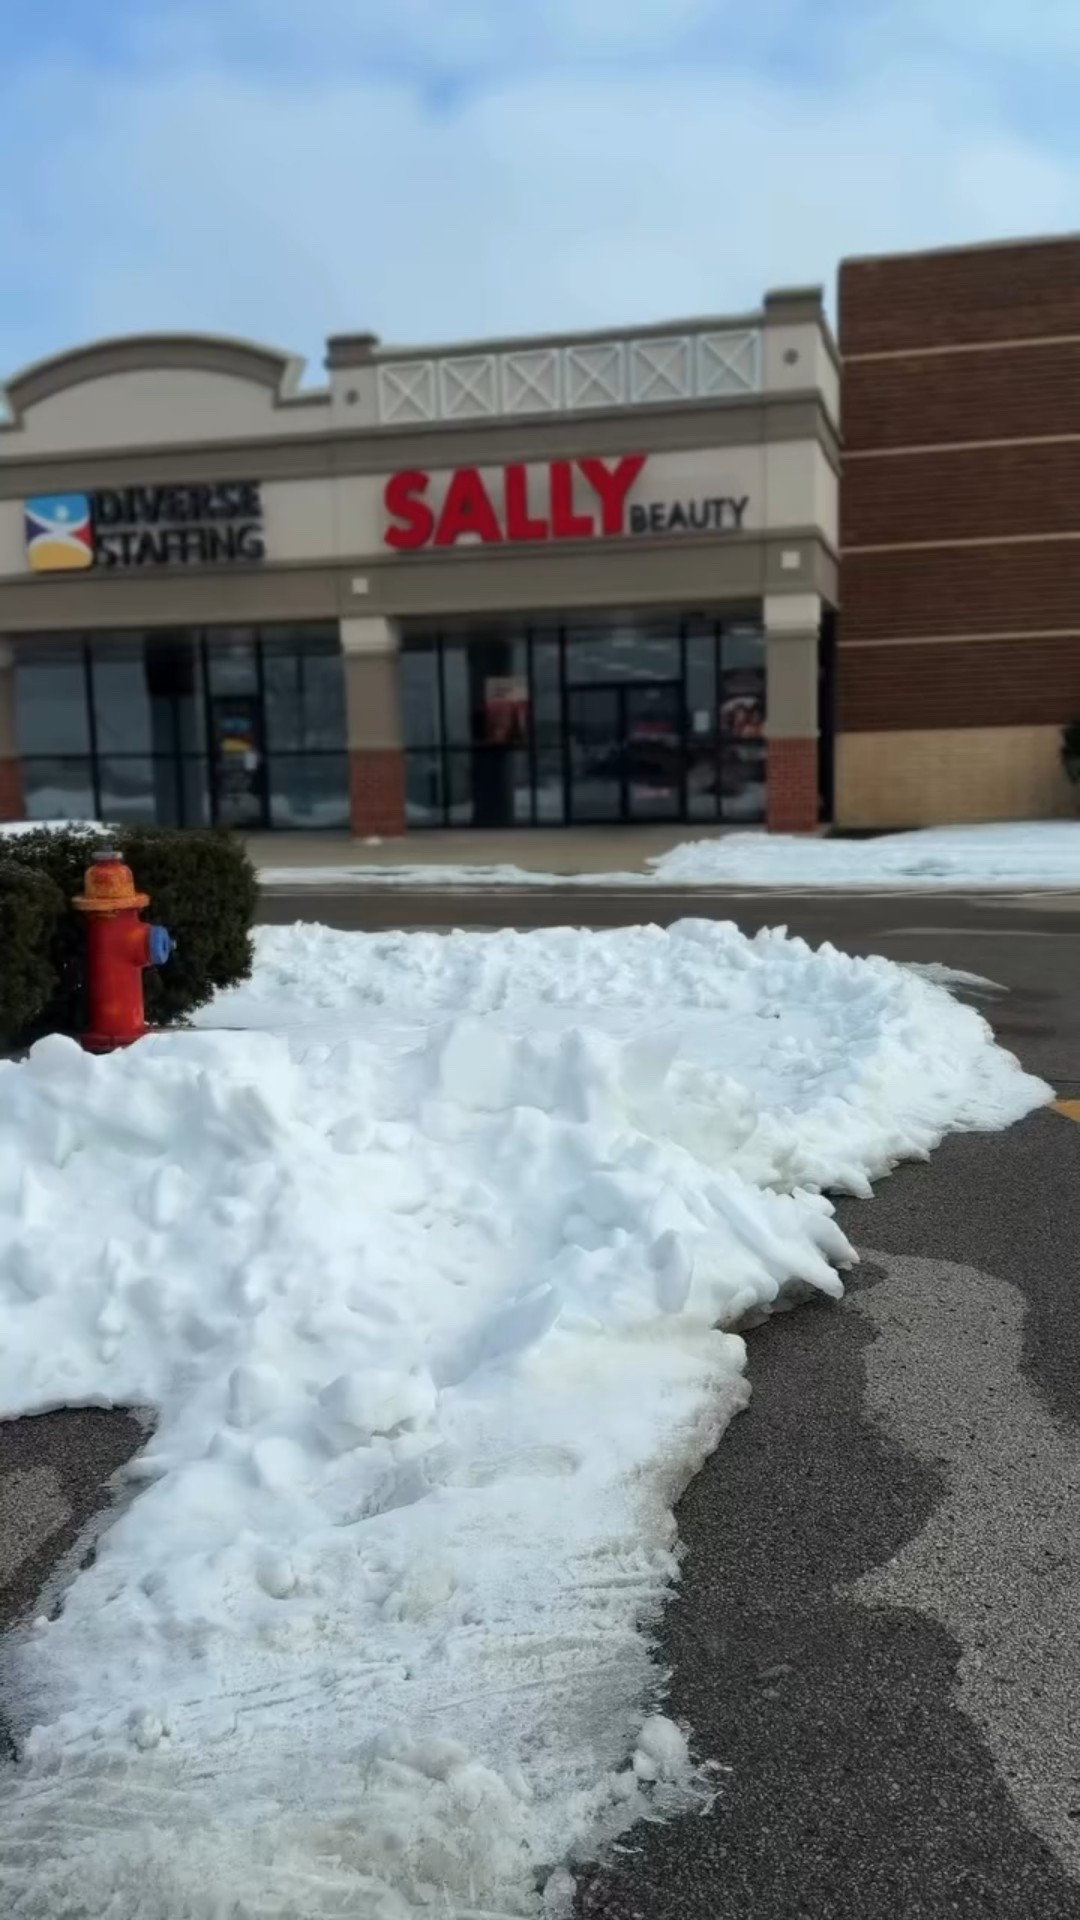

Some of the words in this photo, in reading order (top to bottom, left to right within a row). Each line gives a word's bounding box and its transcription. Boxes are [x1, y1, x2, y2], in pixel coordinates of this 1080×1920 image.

[97, 480, 262, 525] DIVERSE
[384, 452, 647, 550] SALLY
[630, 496, 748, 534] BEAUTY
[95, 524, 265, 570] STAFFING
